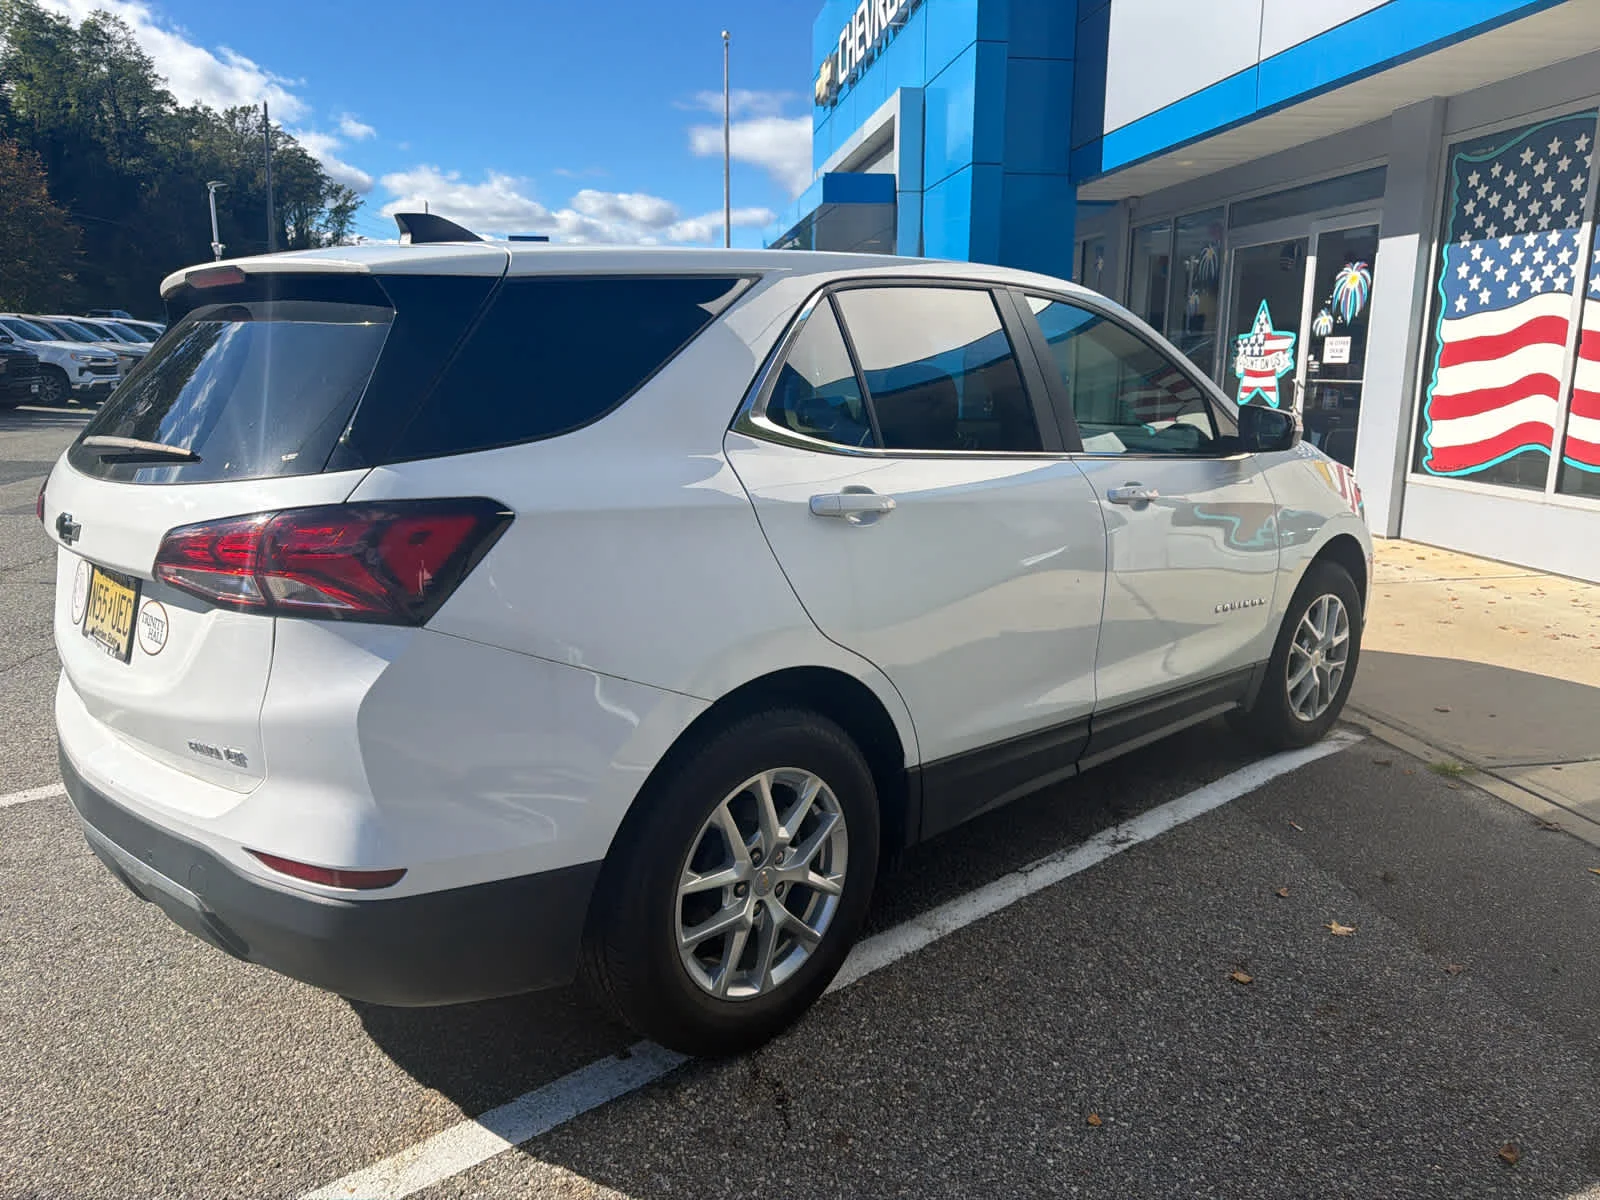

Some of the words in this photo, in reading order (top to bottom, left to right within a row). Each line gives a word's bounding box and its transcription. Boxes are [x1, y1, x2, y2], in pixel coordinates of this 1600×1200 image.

[838, 0, 907, 84] CHEVR
[141, 612, 165, 629] TRINITY
[147, 628, 163, 645] HALL
